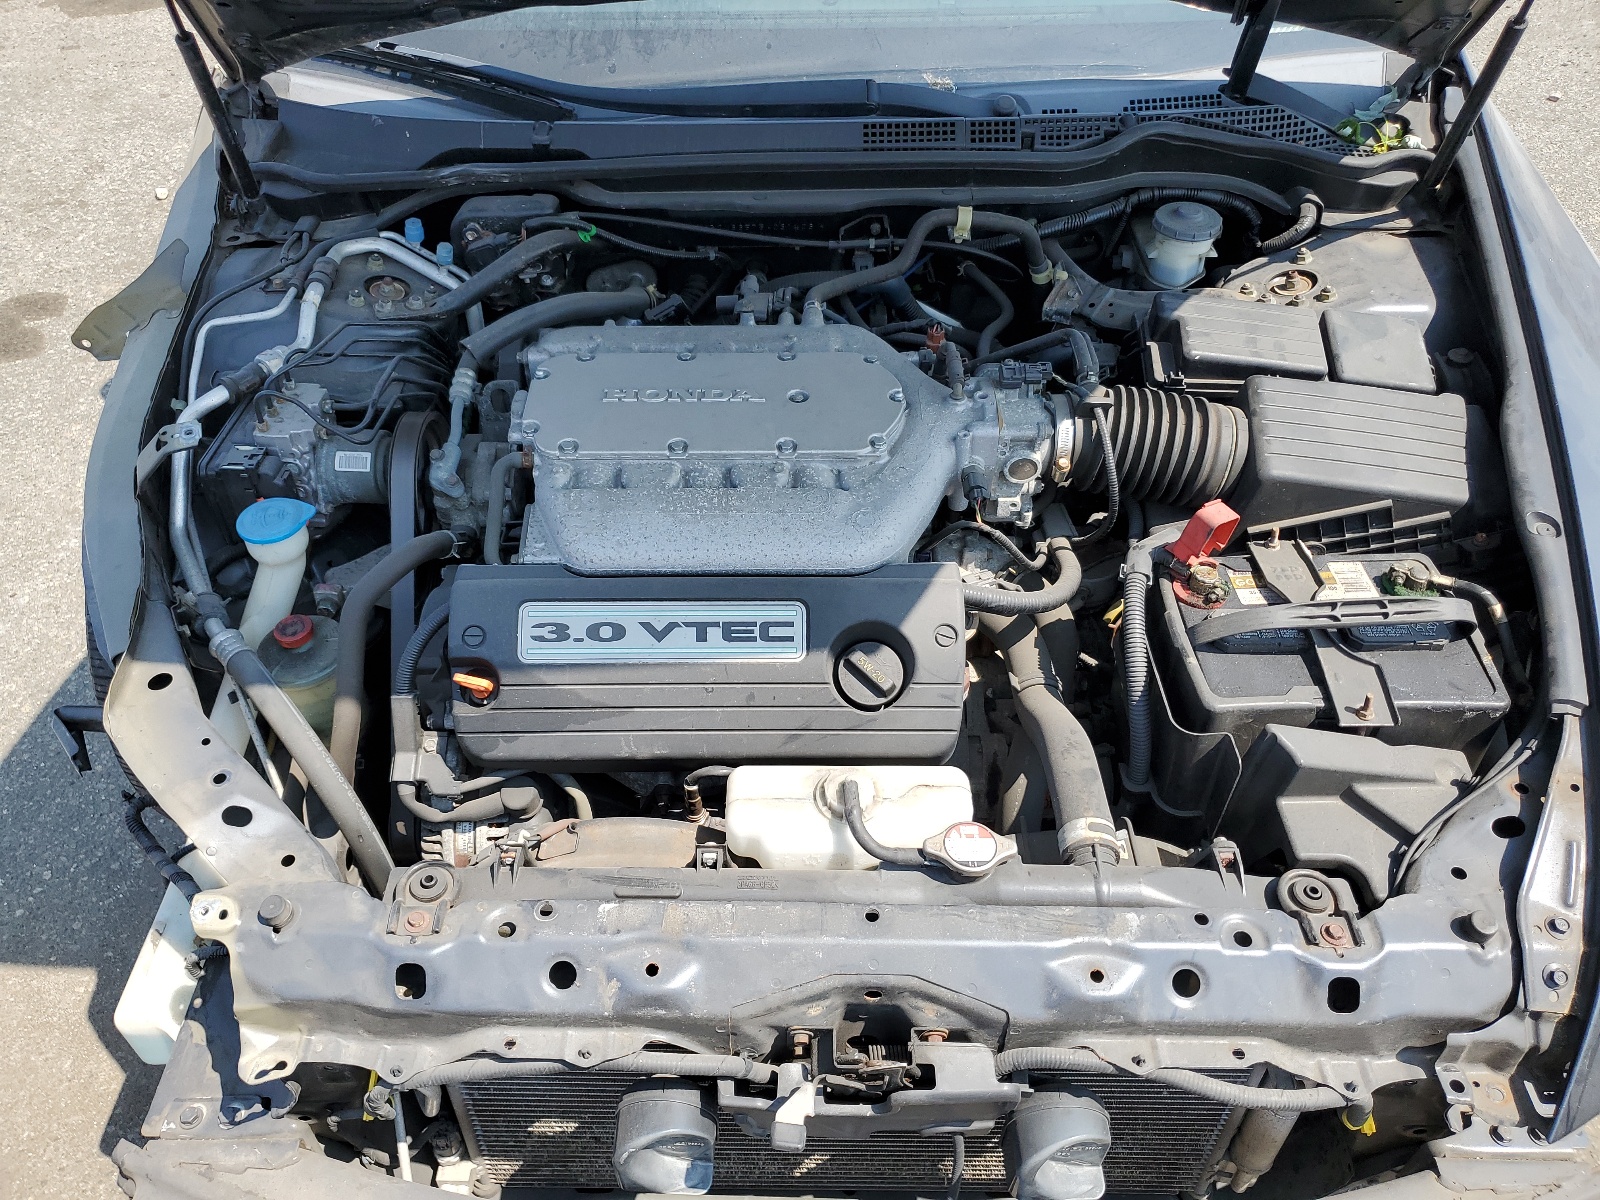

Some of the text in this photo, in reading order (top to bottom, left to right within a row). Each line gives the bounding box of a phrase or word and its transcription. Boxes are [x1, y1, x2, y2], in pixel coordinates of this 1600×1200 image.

[602, 388, 766, 403] HONDA
[529, 621, 795, 644] 3.0 VTEC
[857, 656, 885, 683] 5W-20
